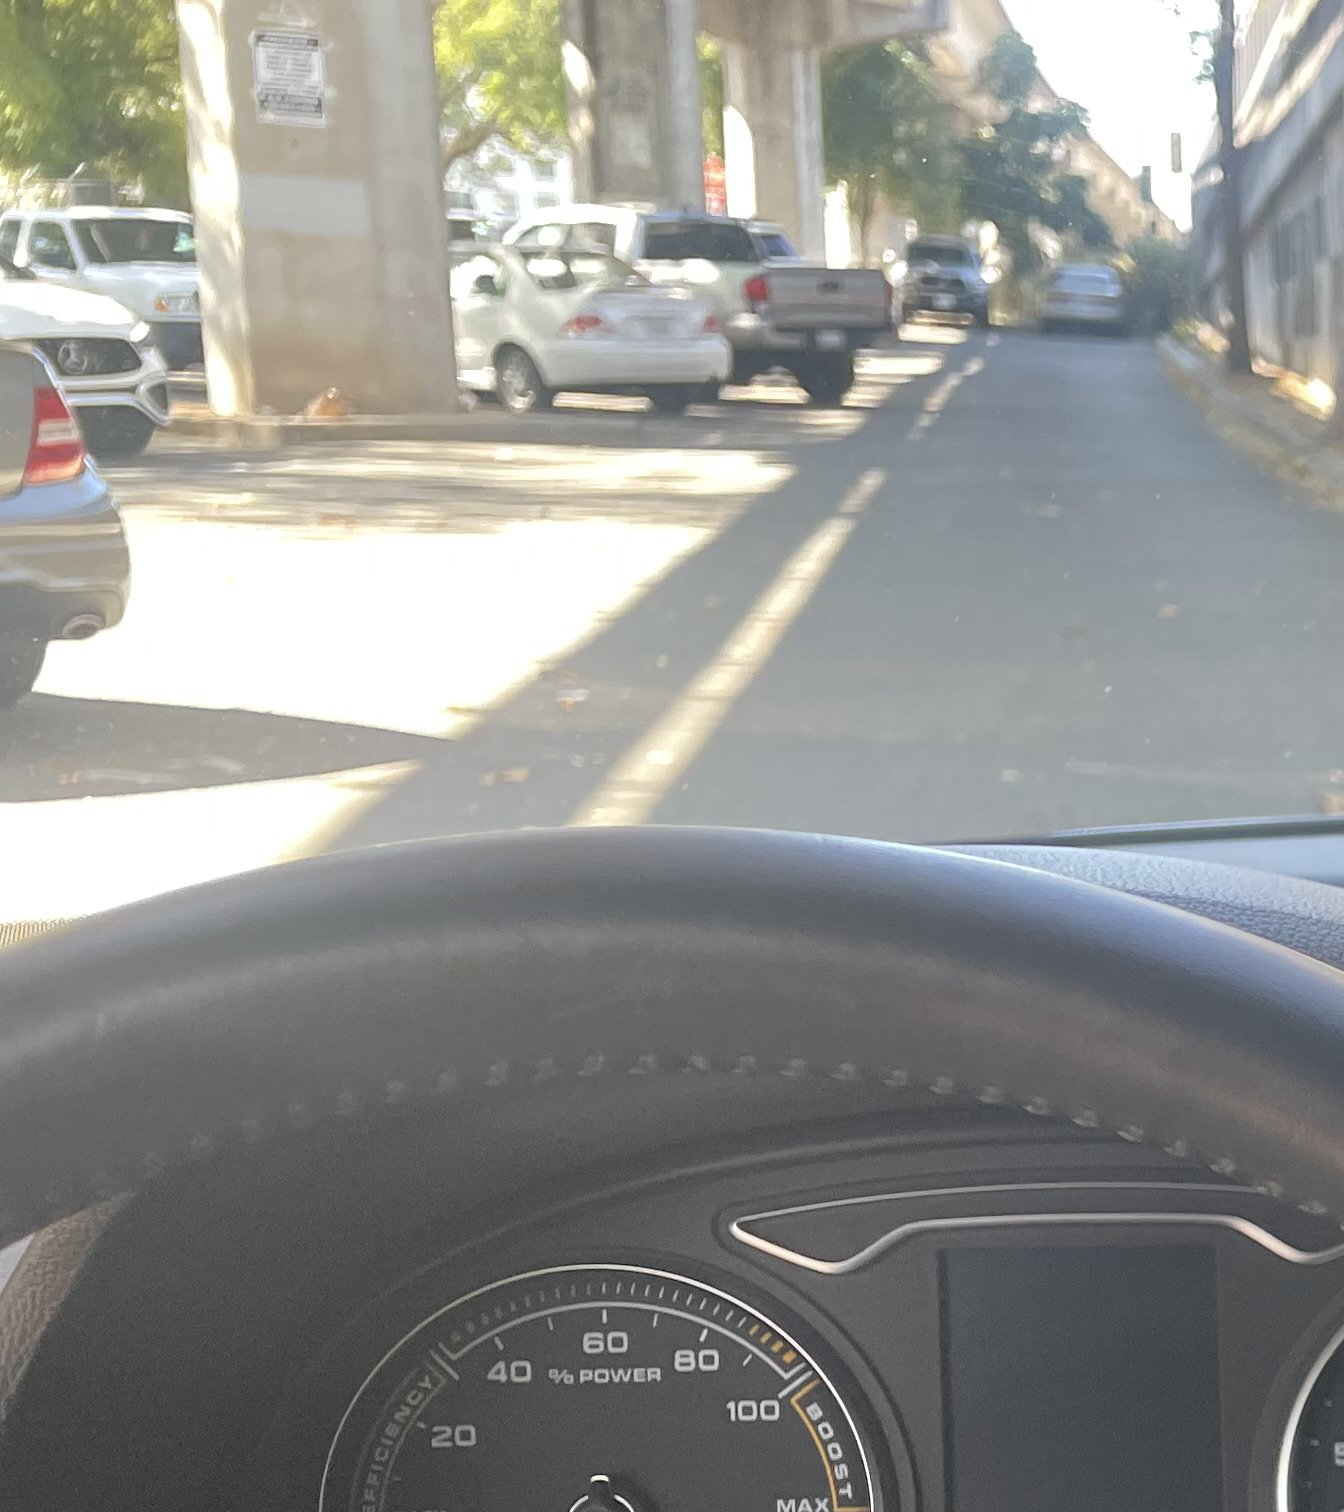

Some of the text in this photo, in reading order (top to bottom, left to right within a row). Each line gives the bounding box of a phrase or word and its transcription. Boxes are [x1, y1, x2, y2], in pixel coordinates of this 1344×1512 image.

[582, 1331, 629, 1354] 60
[487, 1360, 532, 1384] 40
[673, 1349, 720, 1372] 80
[548, 1367, 662, 1385] % POWER
[726, 1399, 780, 1421] 100
[431, 1424, 478, 1448] 20
[805, 1401, 853, 1500] BOOST
